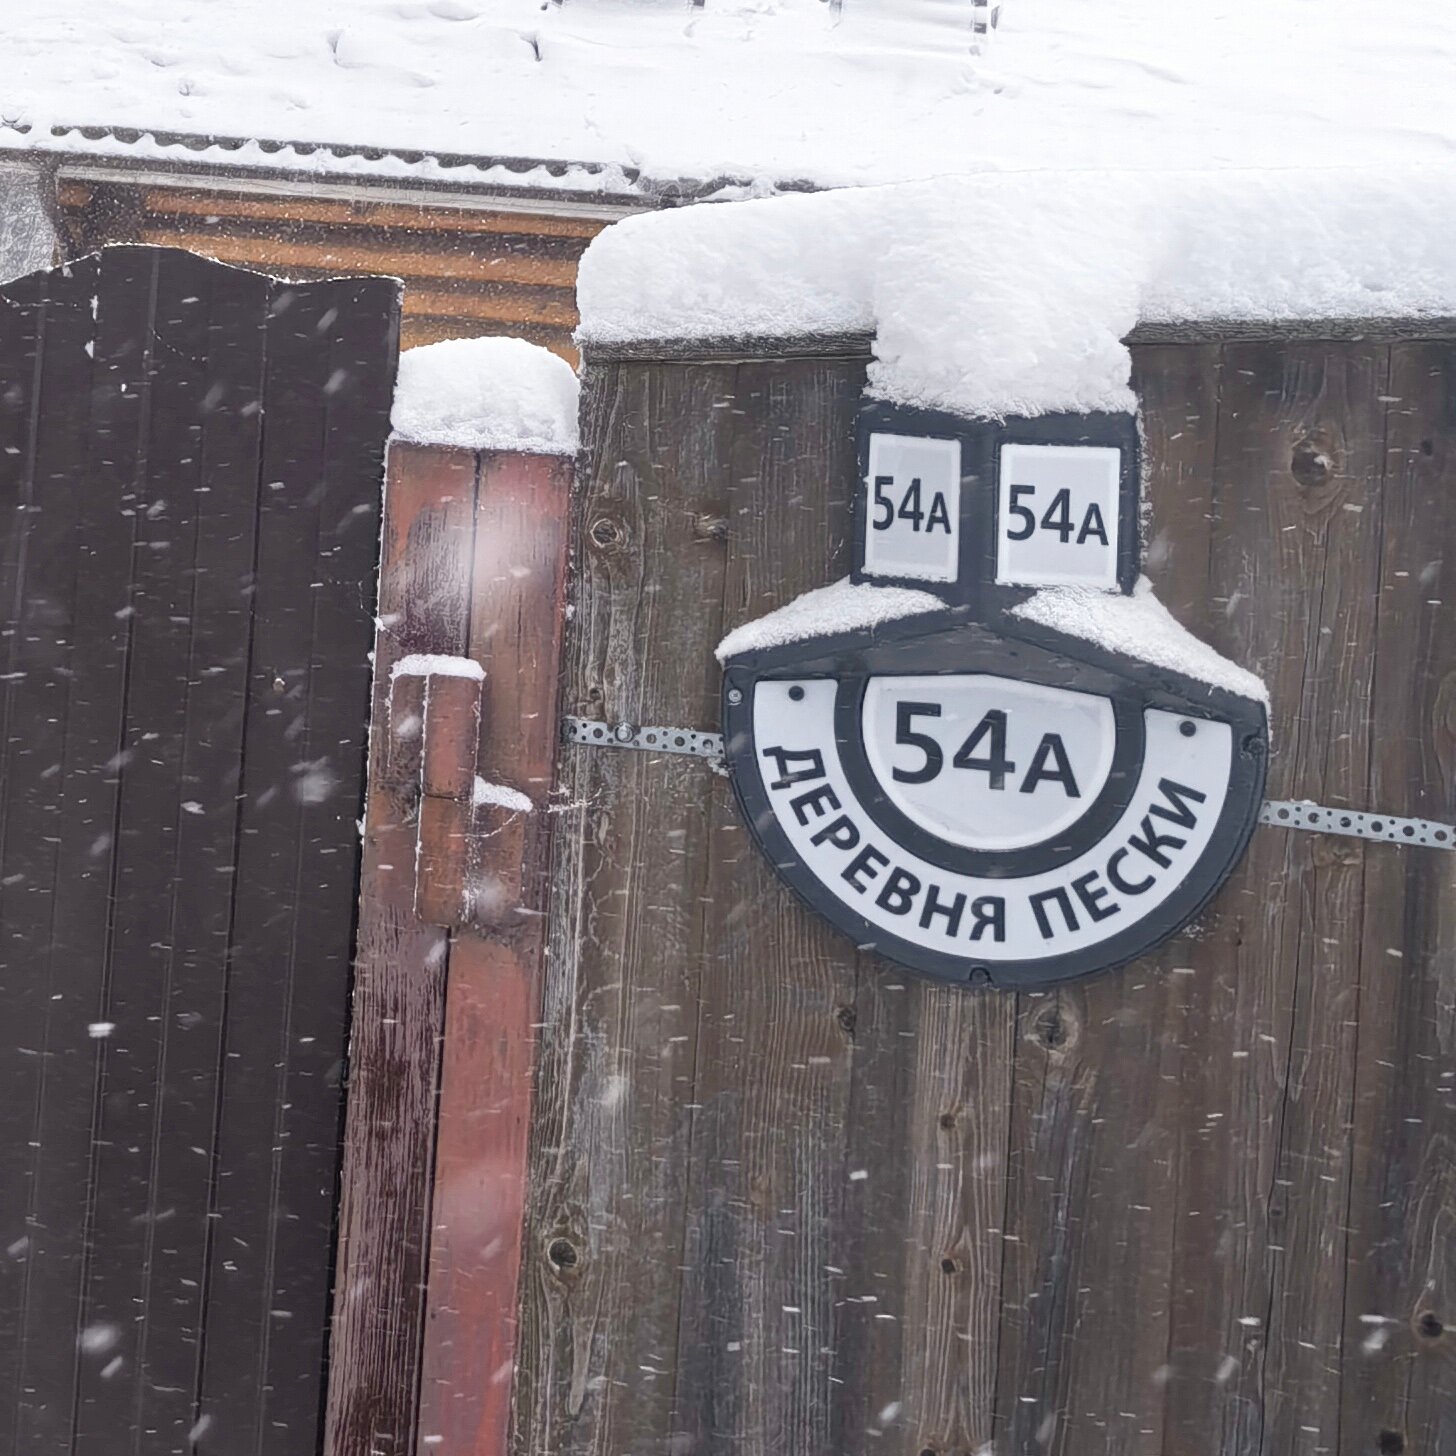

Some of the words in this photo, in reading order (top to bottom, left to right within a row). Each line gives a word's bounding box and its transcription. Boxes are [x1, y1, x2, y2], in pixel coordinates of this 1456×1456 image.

[872, 476, 952, 535] 54А
[1006, 485, 1110, 546] 54А
[891, 701, 1082, 799] 54А
[763, 745, 1007, 943] ДЕРЕВНЯ
[1029, 778, 1207, 940] ПЕСКИ
